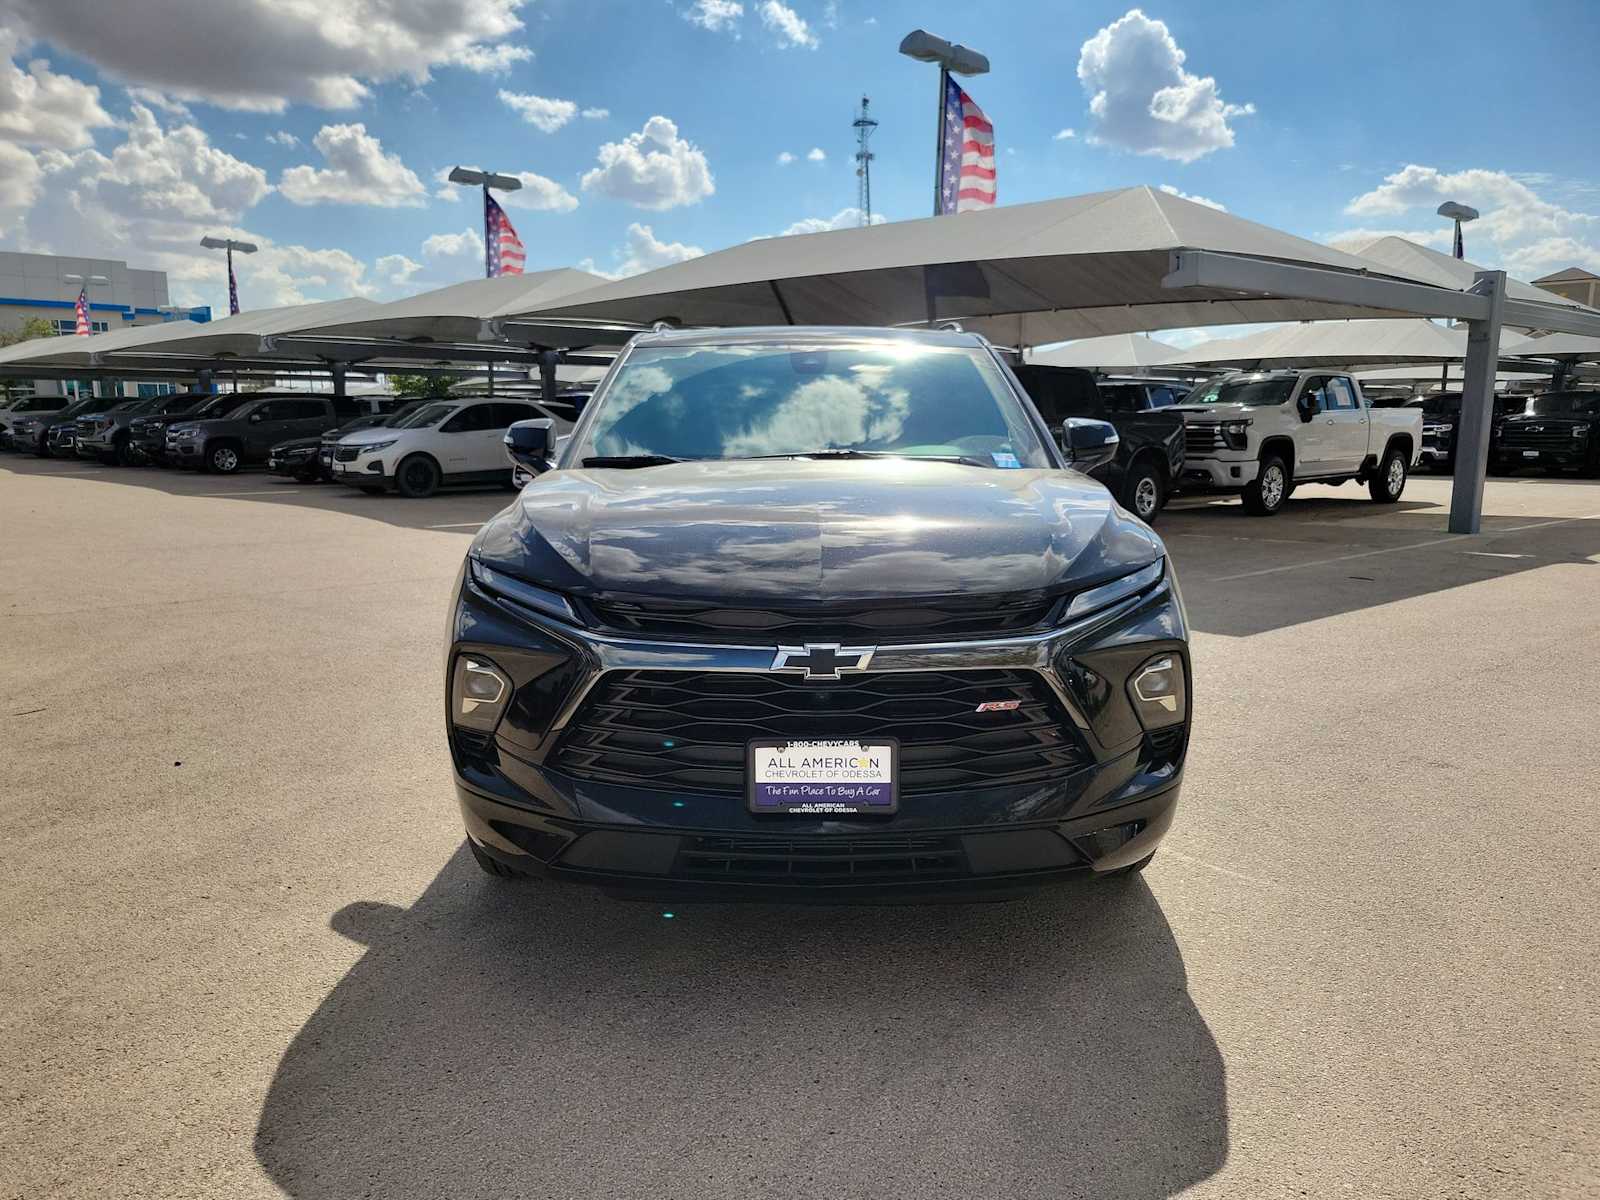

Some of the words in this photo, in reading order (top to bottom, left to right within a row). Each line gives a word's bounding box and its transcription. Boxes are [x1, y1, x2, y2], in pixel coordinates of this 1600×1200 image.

[787, 740, 860, 748] 1-800-CHEVYCARS
[768, 757, 796, 768] ALL
[801, 757, 879, 768] AMERICN
[765, 769, 823, 778] CHEVROLET
[826, 770, 840, 778] OF
[842, 769, 882, 778] ODESSA
[765, 785, 782, 796] The
[783, 785, 800, 795] Fun
[801, 785, 825, 795] Place
[825, 785, 837, 796] To
[838, 786, 856, 799] Buy
[856, 786, 864, 796] A
[866, 786, 881, 796] Car
